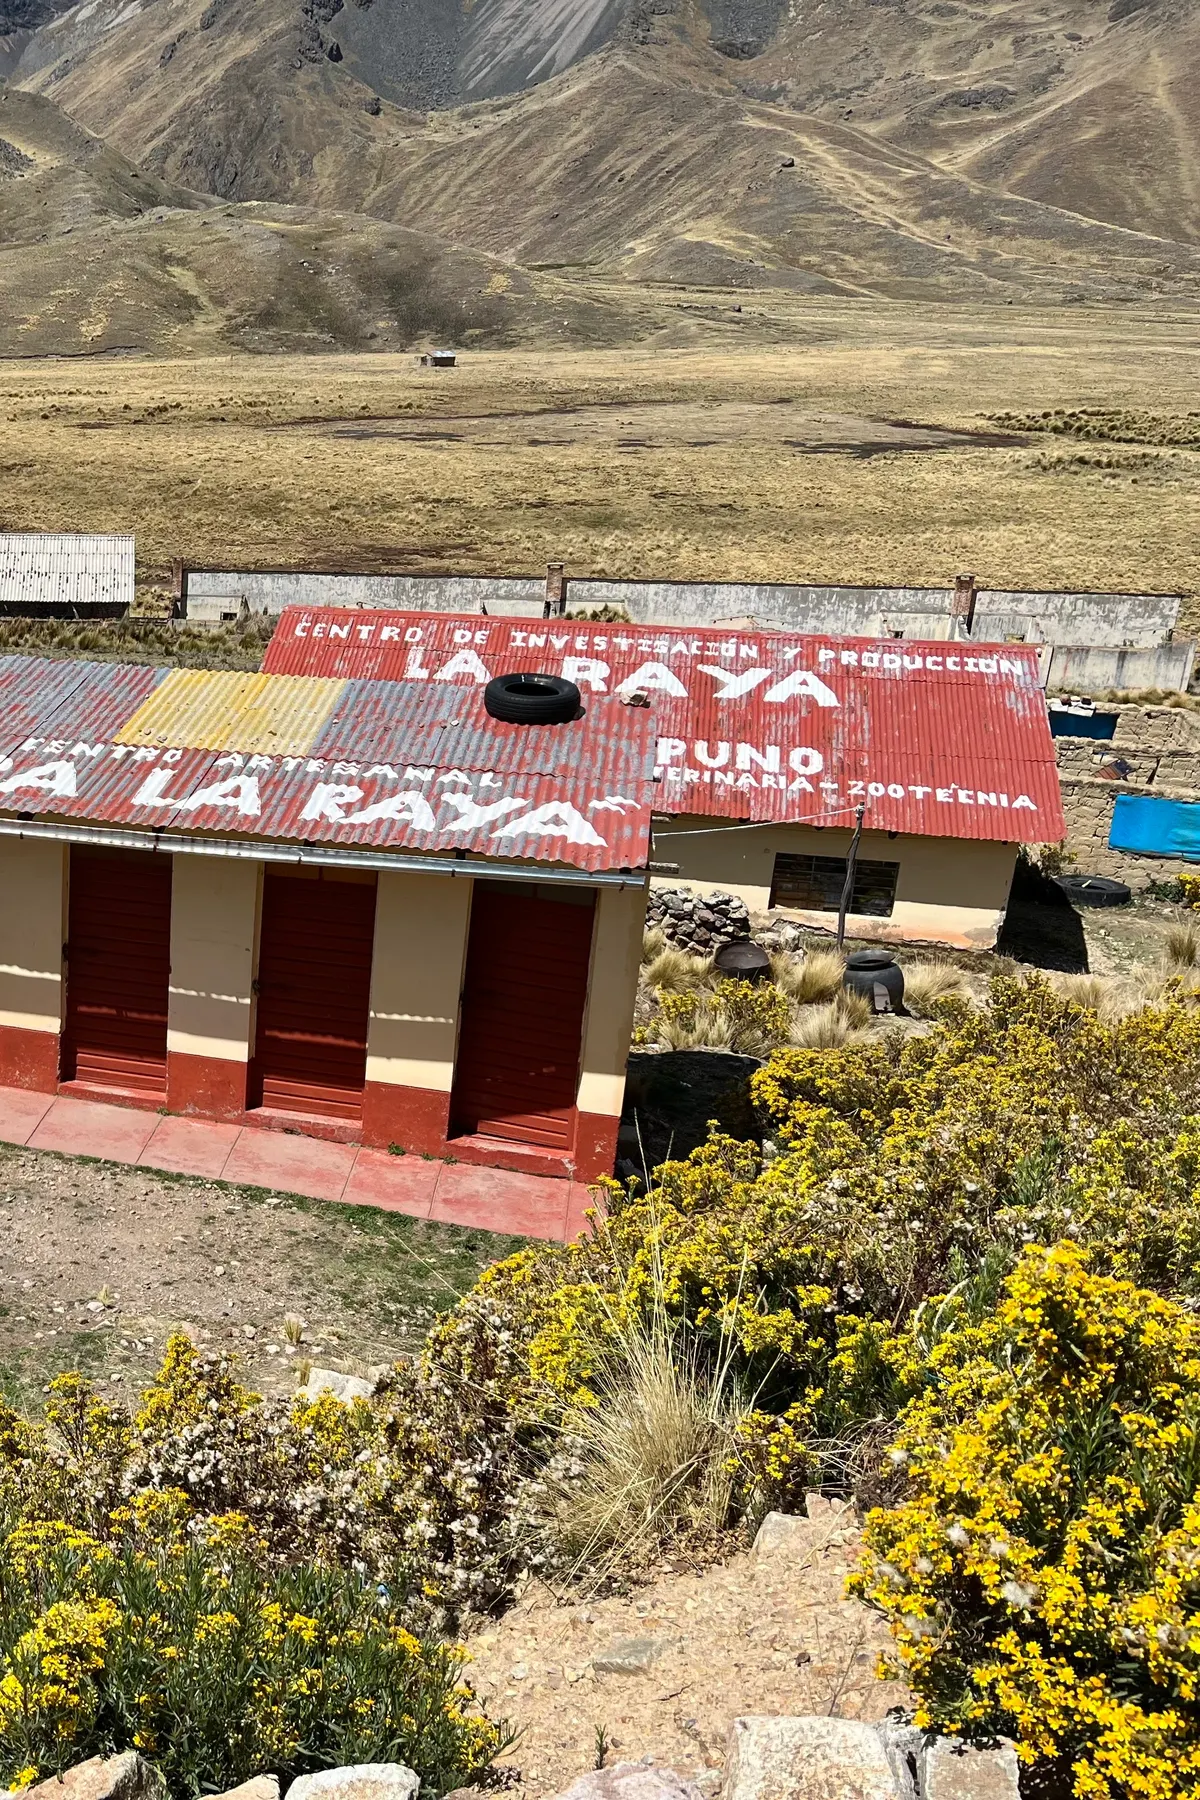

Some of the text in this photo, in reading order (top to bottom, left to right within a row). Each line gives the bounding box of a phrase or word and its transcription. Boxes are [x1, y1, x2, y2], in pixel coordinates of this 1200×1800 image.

[295, 618, 423, 643] CENTRO
[453, 629, 490, 645] DE
[783, 647, 802, 660] Y
[818, 648, 1023, 675] PRODUCCIÓN
[404, 646, 841, 708] LA RAYA
[21, 737, 503, 788] CENTRO ARTESANAL
[657, 737, 824, 776] PUNO
[131, 767, 261, 816] LA
